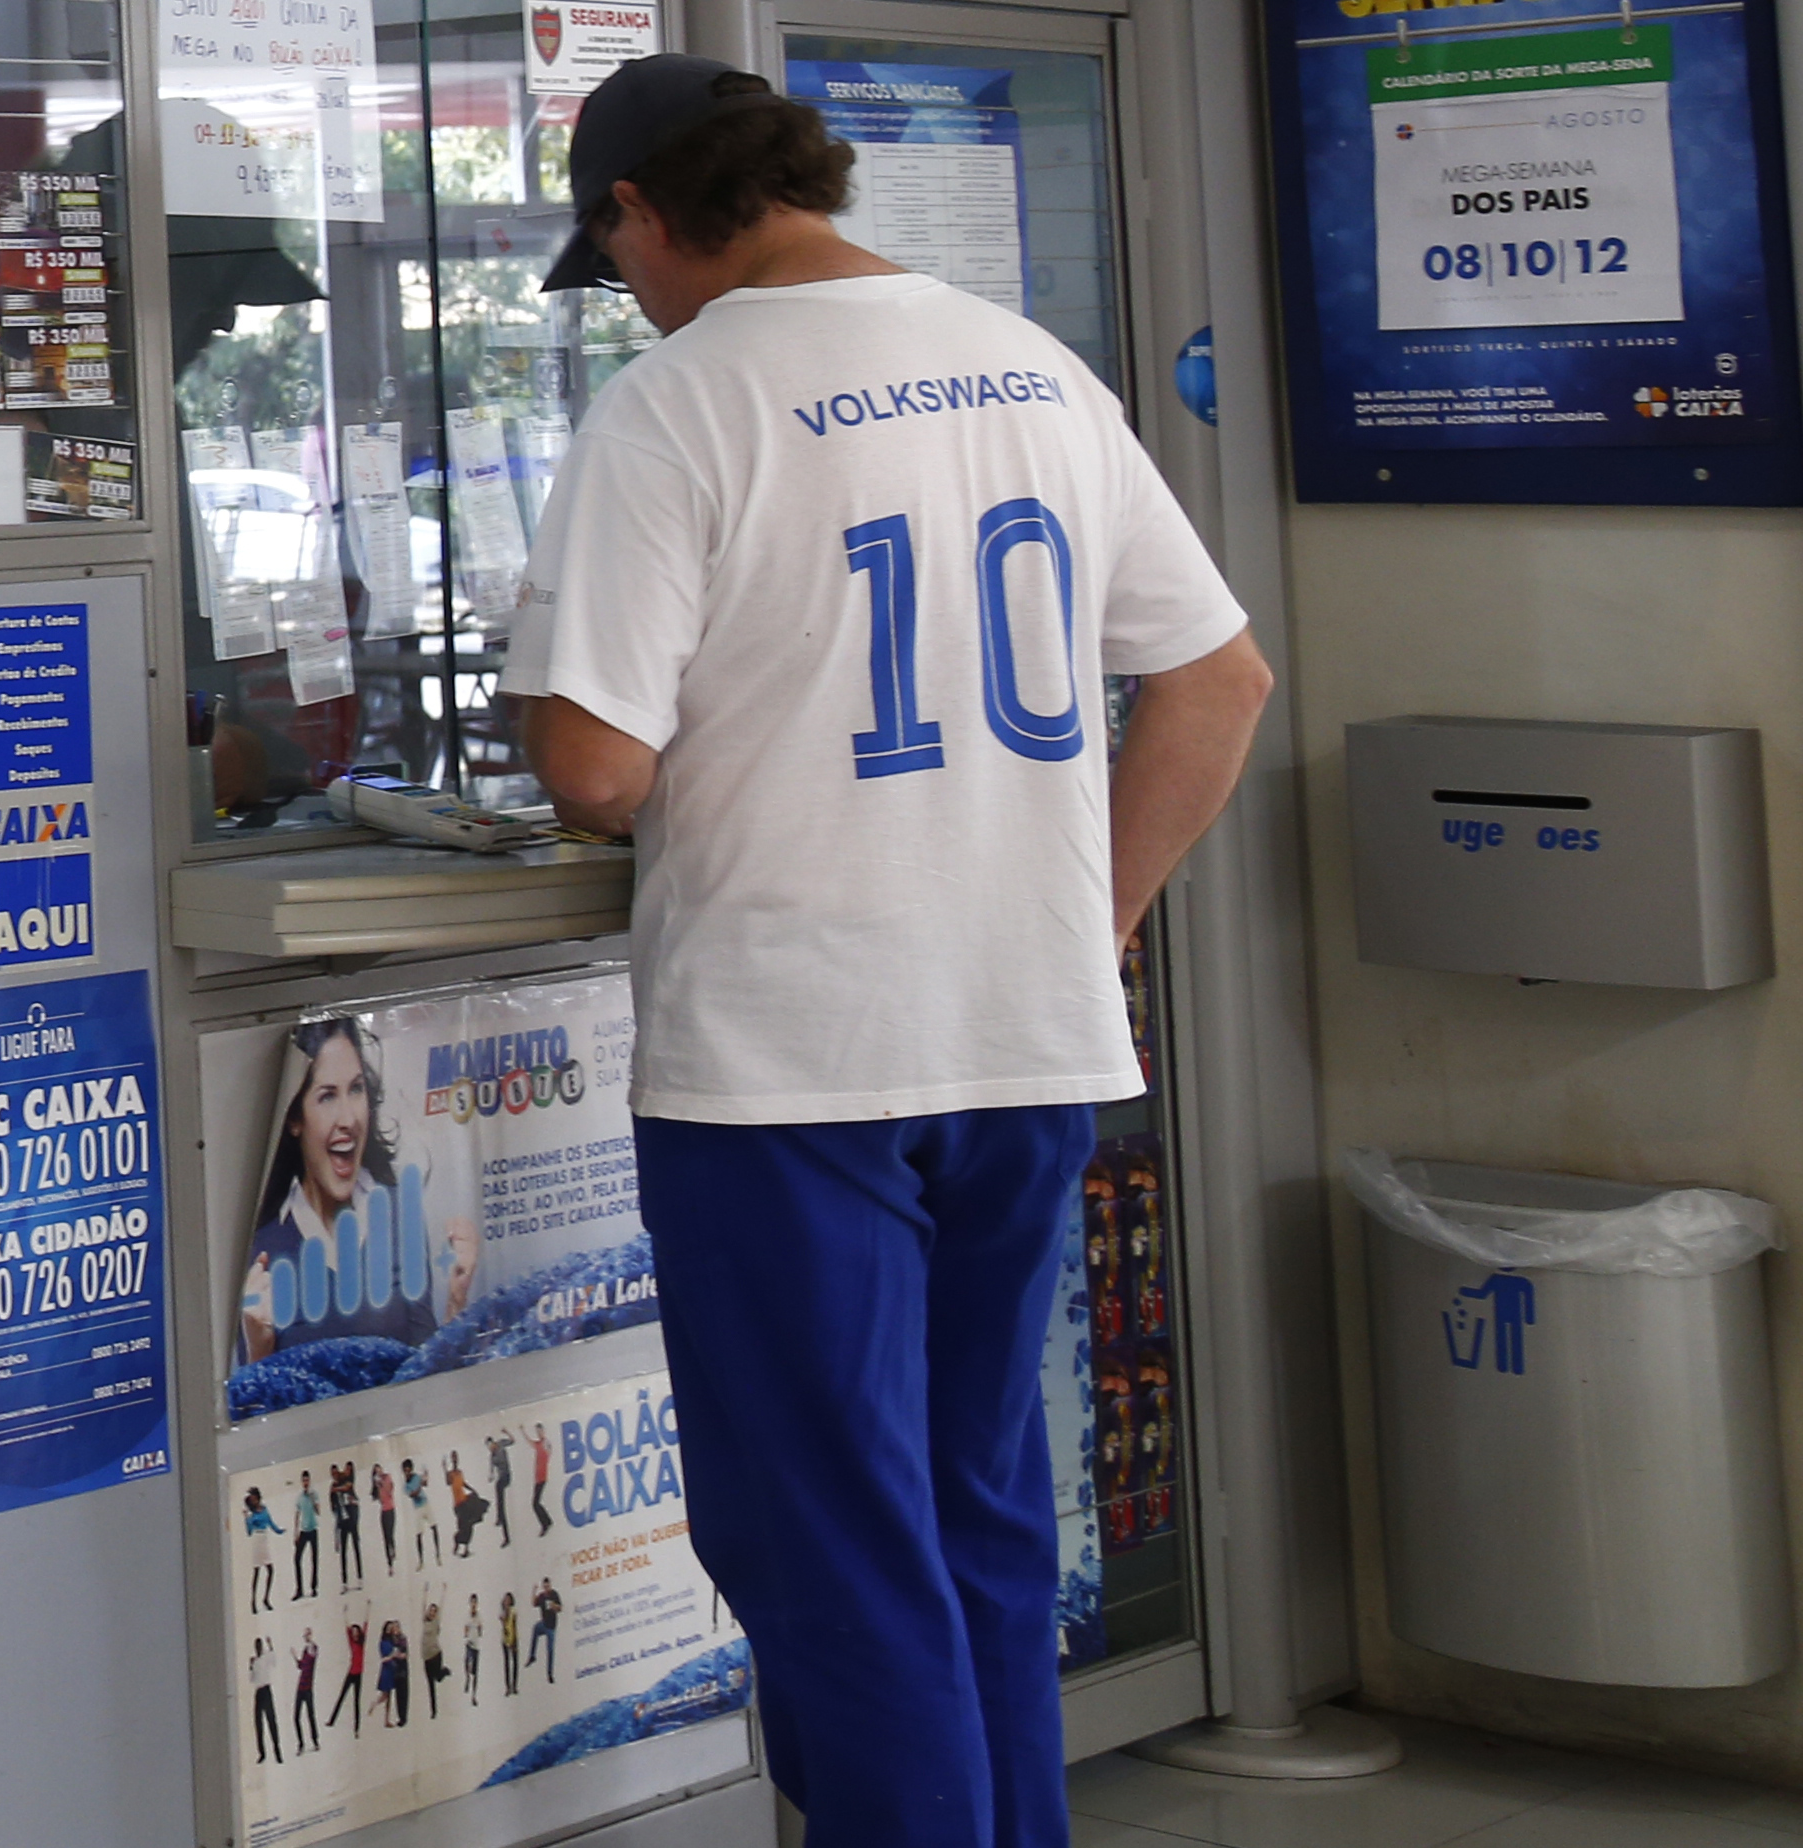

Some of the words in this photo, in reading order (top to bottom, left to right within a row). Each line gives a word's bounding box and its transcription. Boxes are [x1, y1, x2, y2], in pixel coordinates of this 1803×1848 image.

[570, 9, 651, 33] SEGURANÇA
[1382, 71, 1469, 89] CALENDÁRIO
[1471, 70, 1492, 81] DA
[1495, 66, 1539, 80] SORTE
[1542, 63, 1562, 77] DA
[1565, 57, 1654, 74] MEGA-SENA
[826, 81, 891, 102] SERVIÇOS
[1546, 108, 1645, 128] AGOSTO
[1442, 159, 1596, 183] MEGA-SEMANA
[1451, 189, 1513, 215] DOS
[1523, 186, 1590, 212] PAIS
[793, 370, 1068, 437] VOLKSWAGEN
[1501, 399, 1554, 410] APOSTAR
[1673, 386, 1743, 401] loterias
[1675, 401, 1744, 417] CAIXA
[29, 615, 43, 627] de
[45, 614, 80, 627] Contas
[843, 498, 1084, 779] 10
[23, 666, 37, 678] de
[39, 664, 77, 677] Crédito
[0, 692, 65, 707] Pagamentos
[14, 743, 52, 757] Saques
[8, 767, 60, 784] Depósitos
[1442, 817, 1505, 853] uge
[1536, 822, 1602, 853] oes
[0, 1031, 40, 1062] LIGUE
[42, 1026, 75, 1056] PARA
[427, 1024, 569, 1090] MOMENTO
[23, 1074, 146, 1132] CAIXA
[17, 1132, 71, 1193] 726
[79, 1119, 149, 1182] 0101
[483, 1152, 563, 1176] ACOMPANHE
[566, 1146, 583, 1161] OS
[586, 1136, 635, 1159] SORTEIO
[483, 1179, 509, 1197] DAS
[513, 1169, 568, 1191] LOTERIAS
[571, 1166, 585, 1181] DE
[534, 1195, 551, 1210] AO
[593, 1181, 618, 1197] PELA
[29, 1206, 148, 1256] CIDADÃO
[20, 1256, 72, 1316] 726
[81, 1241, 148, 1305] 0207
[536, 1285, 608, 1322] CAIXA
[560, 1389, 678, 1475] BOLÃO
[122, 1450, 166, 1473] CAIXA
[562, 1457, 684, 1530] CAIXA
[571, 1542, 601, 1566] VOCÊ
[603, 1537, 629, 1555] NÃO
[632, 1532, 648, 1547] VAI
[571, 1567, 603, 1587] FICAR
[605, 1562, 619, 1579] DE
